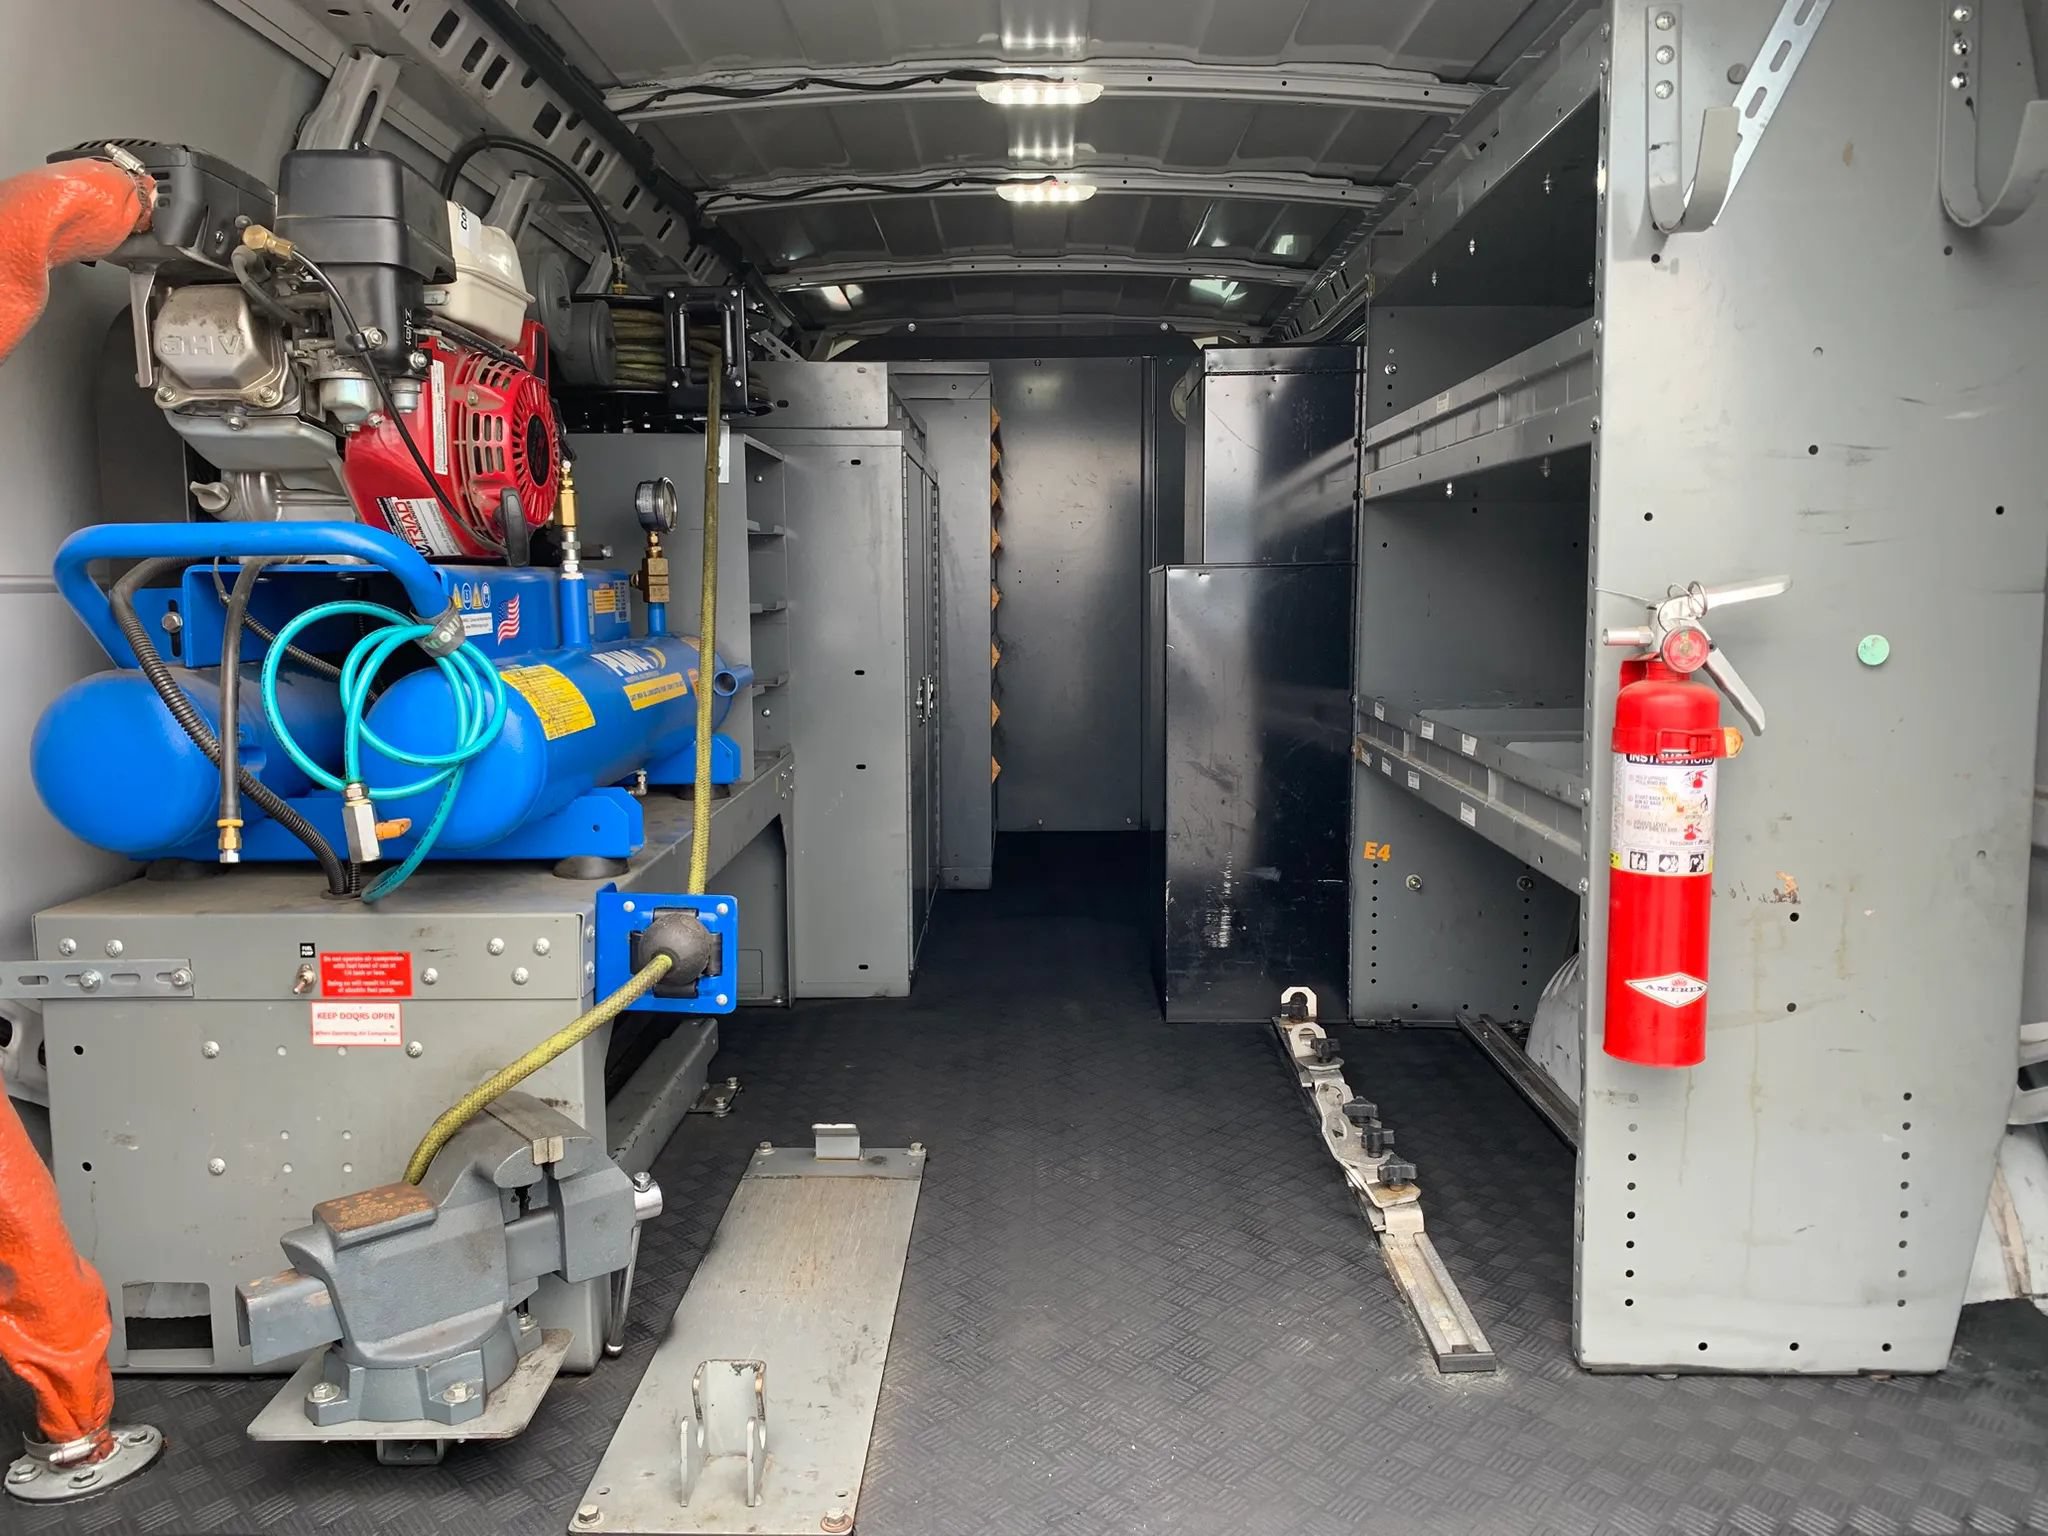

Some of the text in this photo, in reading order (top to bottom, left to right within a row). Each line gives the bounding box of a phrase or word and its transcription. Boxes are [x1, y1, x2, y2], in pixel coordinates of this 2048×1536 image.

[160, 335, 242, 356] OHV
[395, 502, 424, 547] TRIAD
[1364, 841, 1391, 862] E4
[1645, 984, 1704, 993] AMEREX
[317, 1012, 395, 1020] KEEP DOORS OPEN
